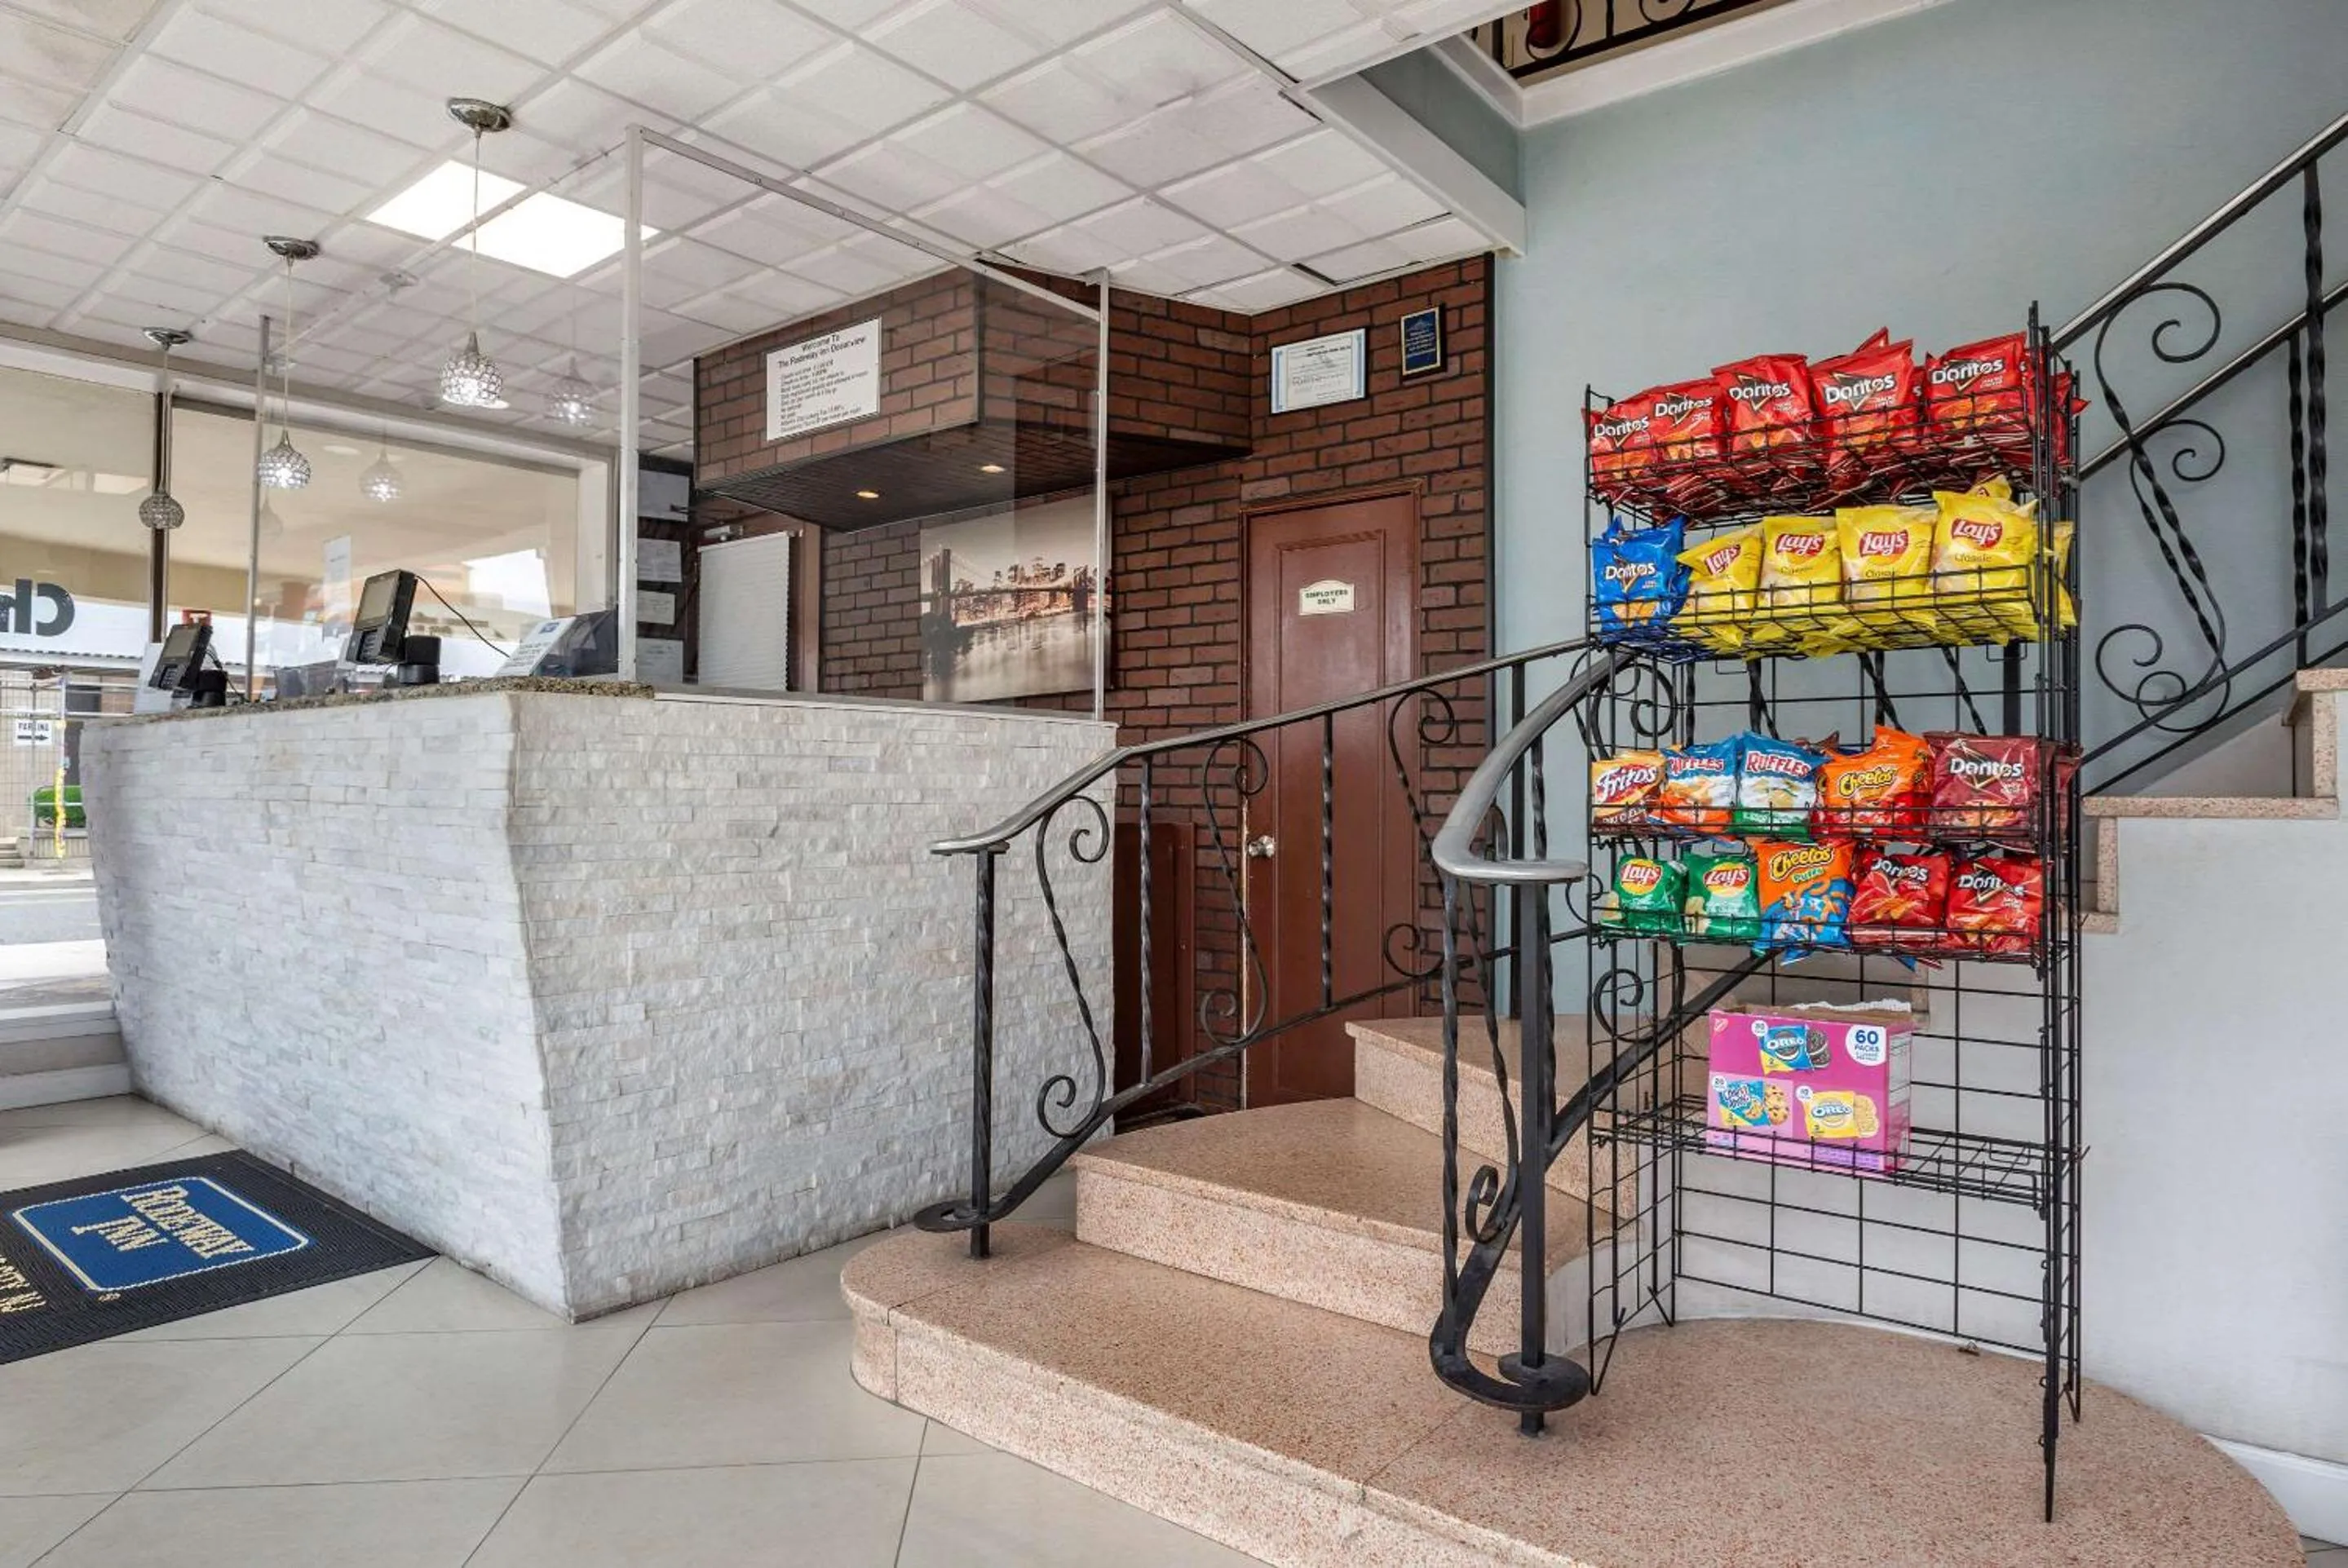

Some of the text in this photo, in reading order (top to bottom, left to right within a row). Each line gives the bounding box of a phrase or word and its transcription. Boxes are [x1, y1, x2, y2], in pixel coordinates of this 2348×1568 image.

[1931, 359, 2005, 385] Doritos
[1729, 381, 1791, 400] Doritos
[1824, 373, 1896, 404] Doritos
[1655, 395, 1713, 417] Doritos
[1594, 415, 1650, 437] Doritos
[1605, 561, 1657, 581] Doritos
[1305, 589, 1348, 598] EMPLOYEES
[1746, 750, 1811, 777] RUFFLES
[1949, 757, 2023, 778] Doritos
[1595, 765, 1657, 802] Fritos
[1839, 764, 1896, 797] Cheetos
[1770, 846, 1833, 881] Cheetos
[1767, 1036, 1804, 1050] OREO
[1855, 1029, 1879, 1045] 60
[1811, 1104, 1852, 1118] OREO
[71, 1214, 169, 1253] INN
[121, 1186, 255, 1260] RODEWAY
